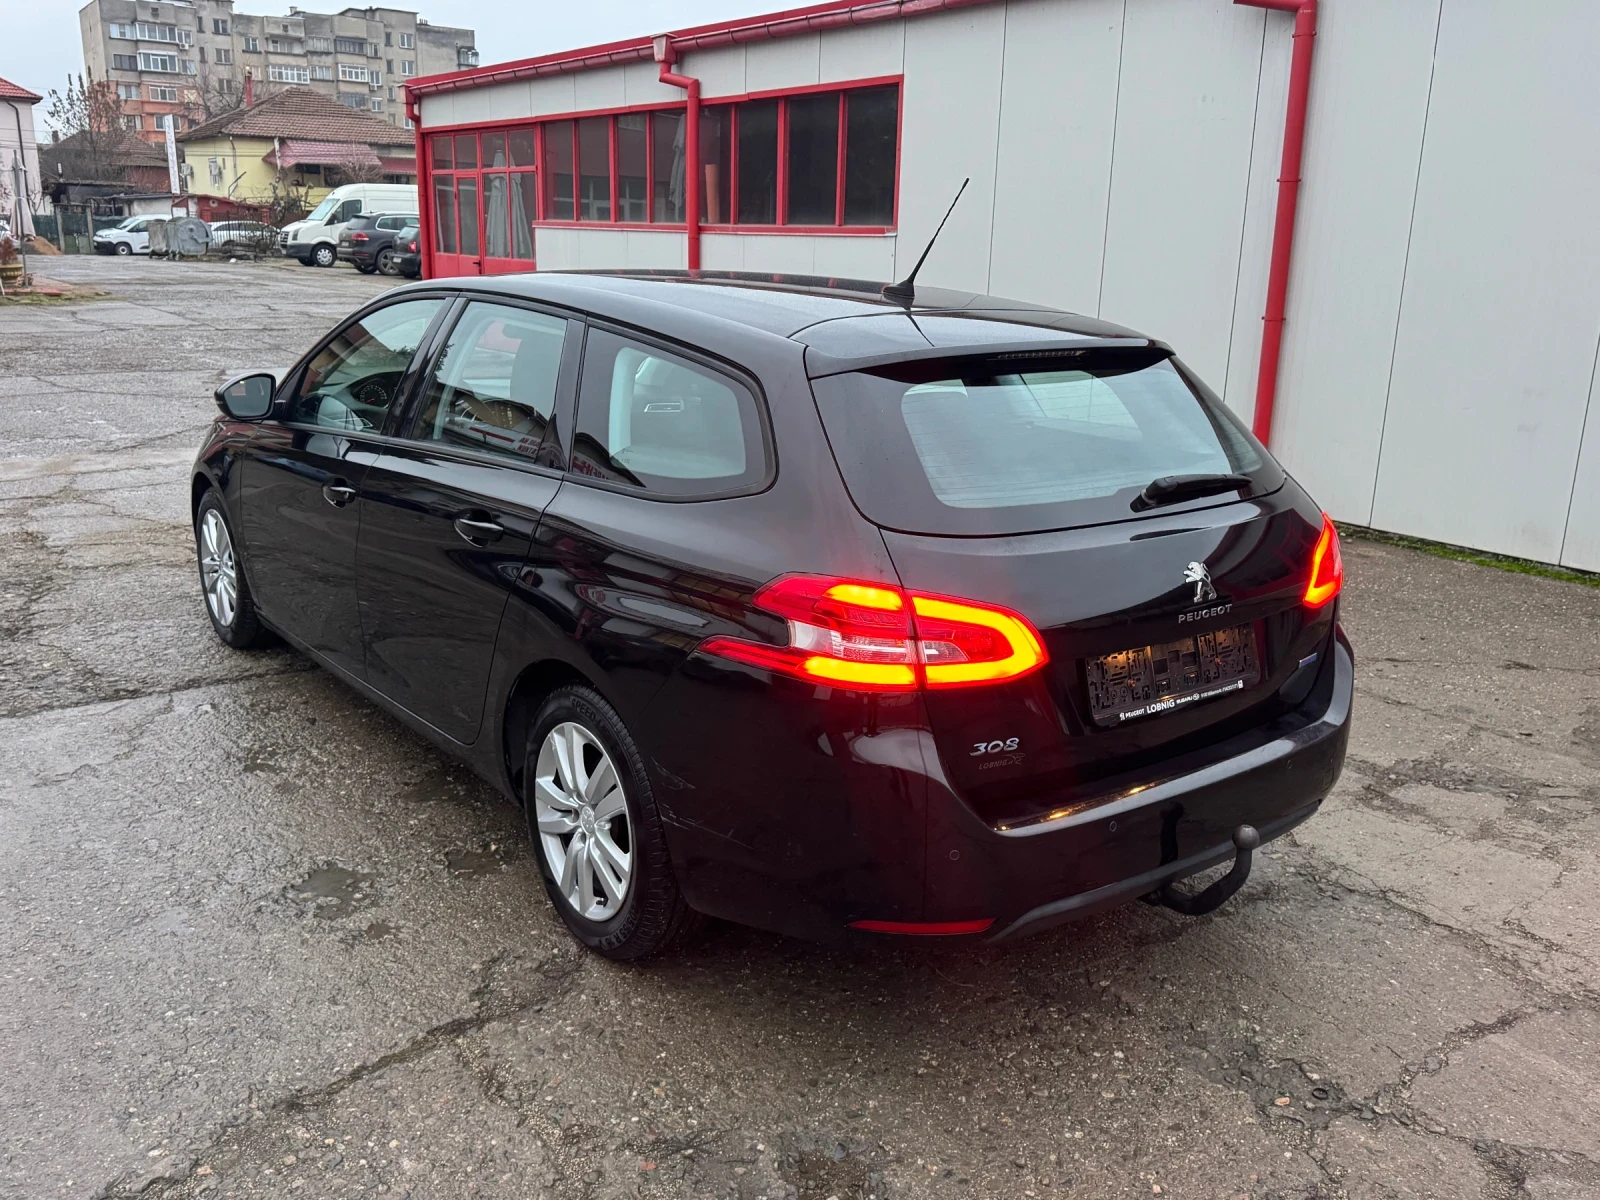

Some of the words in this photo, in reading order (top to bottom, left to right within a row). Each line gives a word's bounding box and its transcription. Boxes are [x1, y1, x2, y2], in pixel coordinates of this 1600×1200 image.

[1178, 604, 1232, 624] PEUGEOT
[1146, 699, 1176, 714] LOBNIG
[969, 737, 1019, 756] 308
